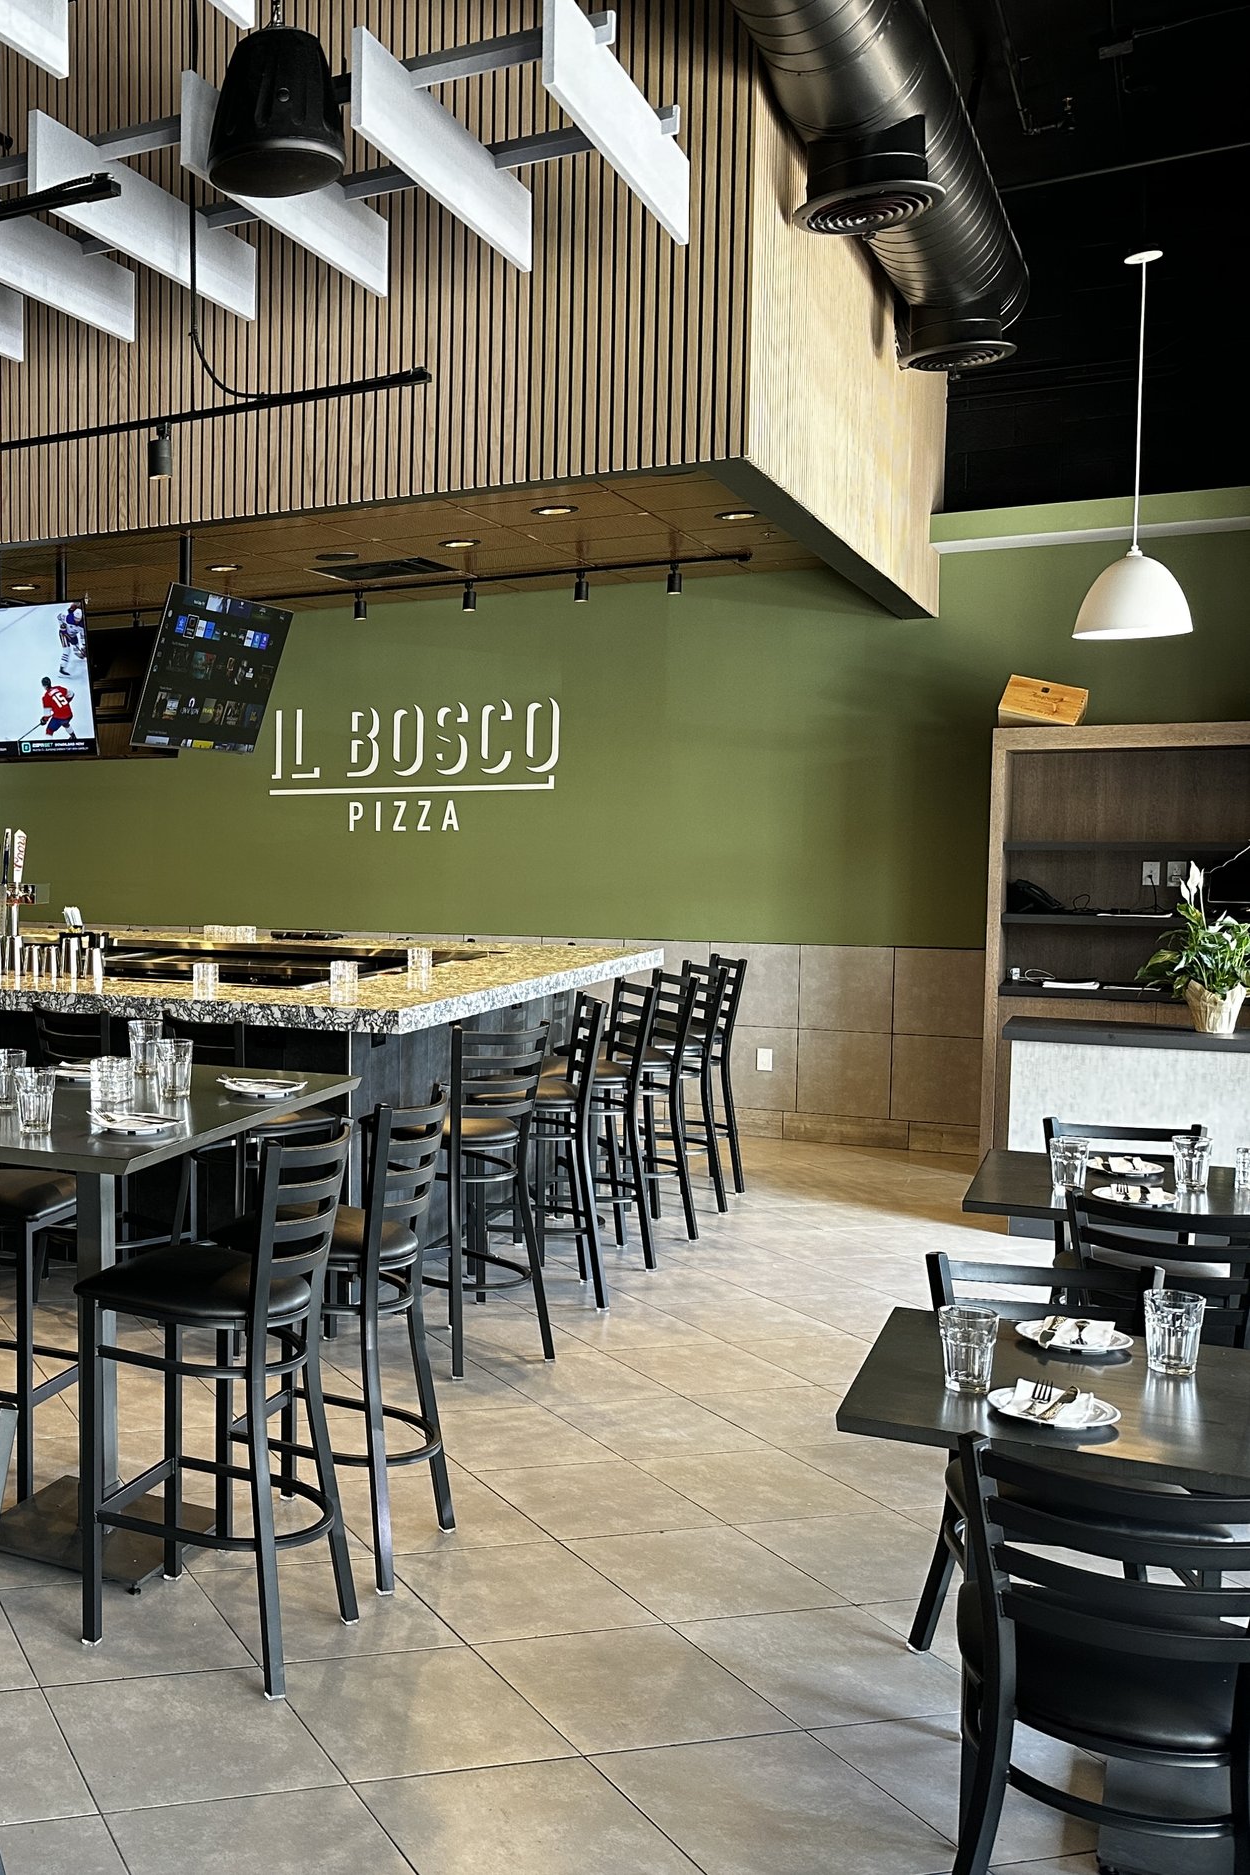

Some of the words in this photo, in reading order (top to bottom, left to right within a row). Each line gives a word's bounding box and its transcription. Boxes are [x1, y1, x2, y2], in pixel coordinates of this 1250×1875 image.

[52, 691, 69, 708] 15
[271, 708, 320, 780] IL
[346, 696, 561, 778] BOSCO
[348, 799, 460, 832] PIZZA
[13, 835, 27, 871] Coors
